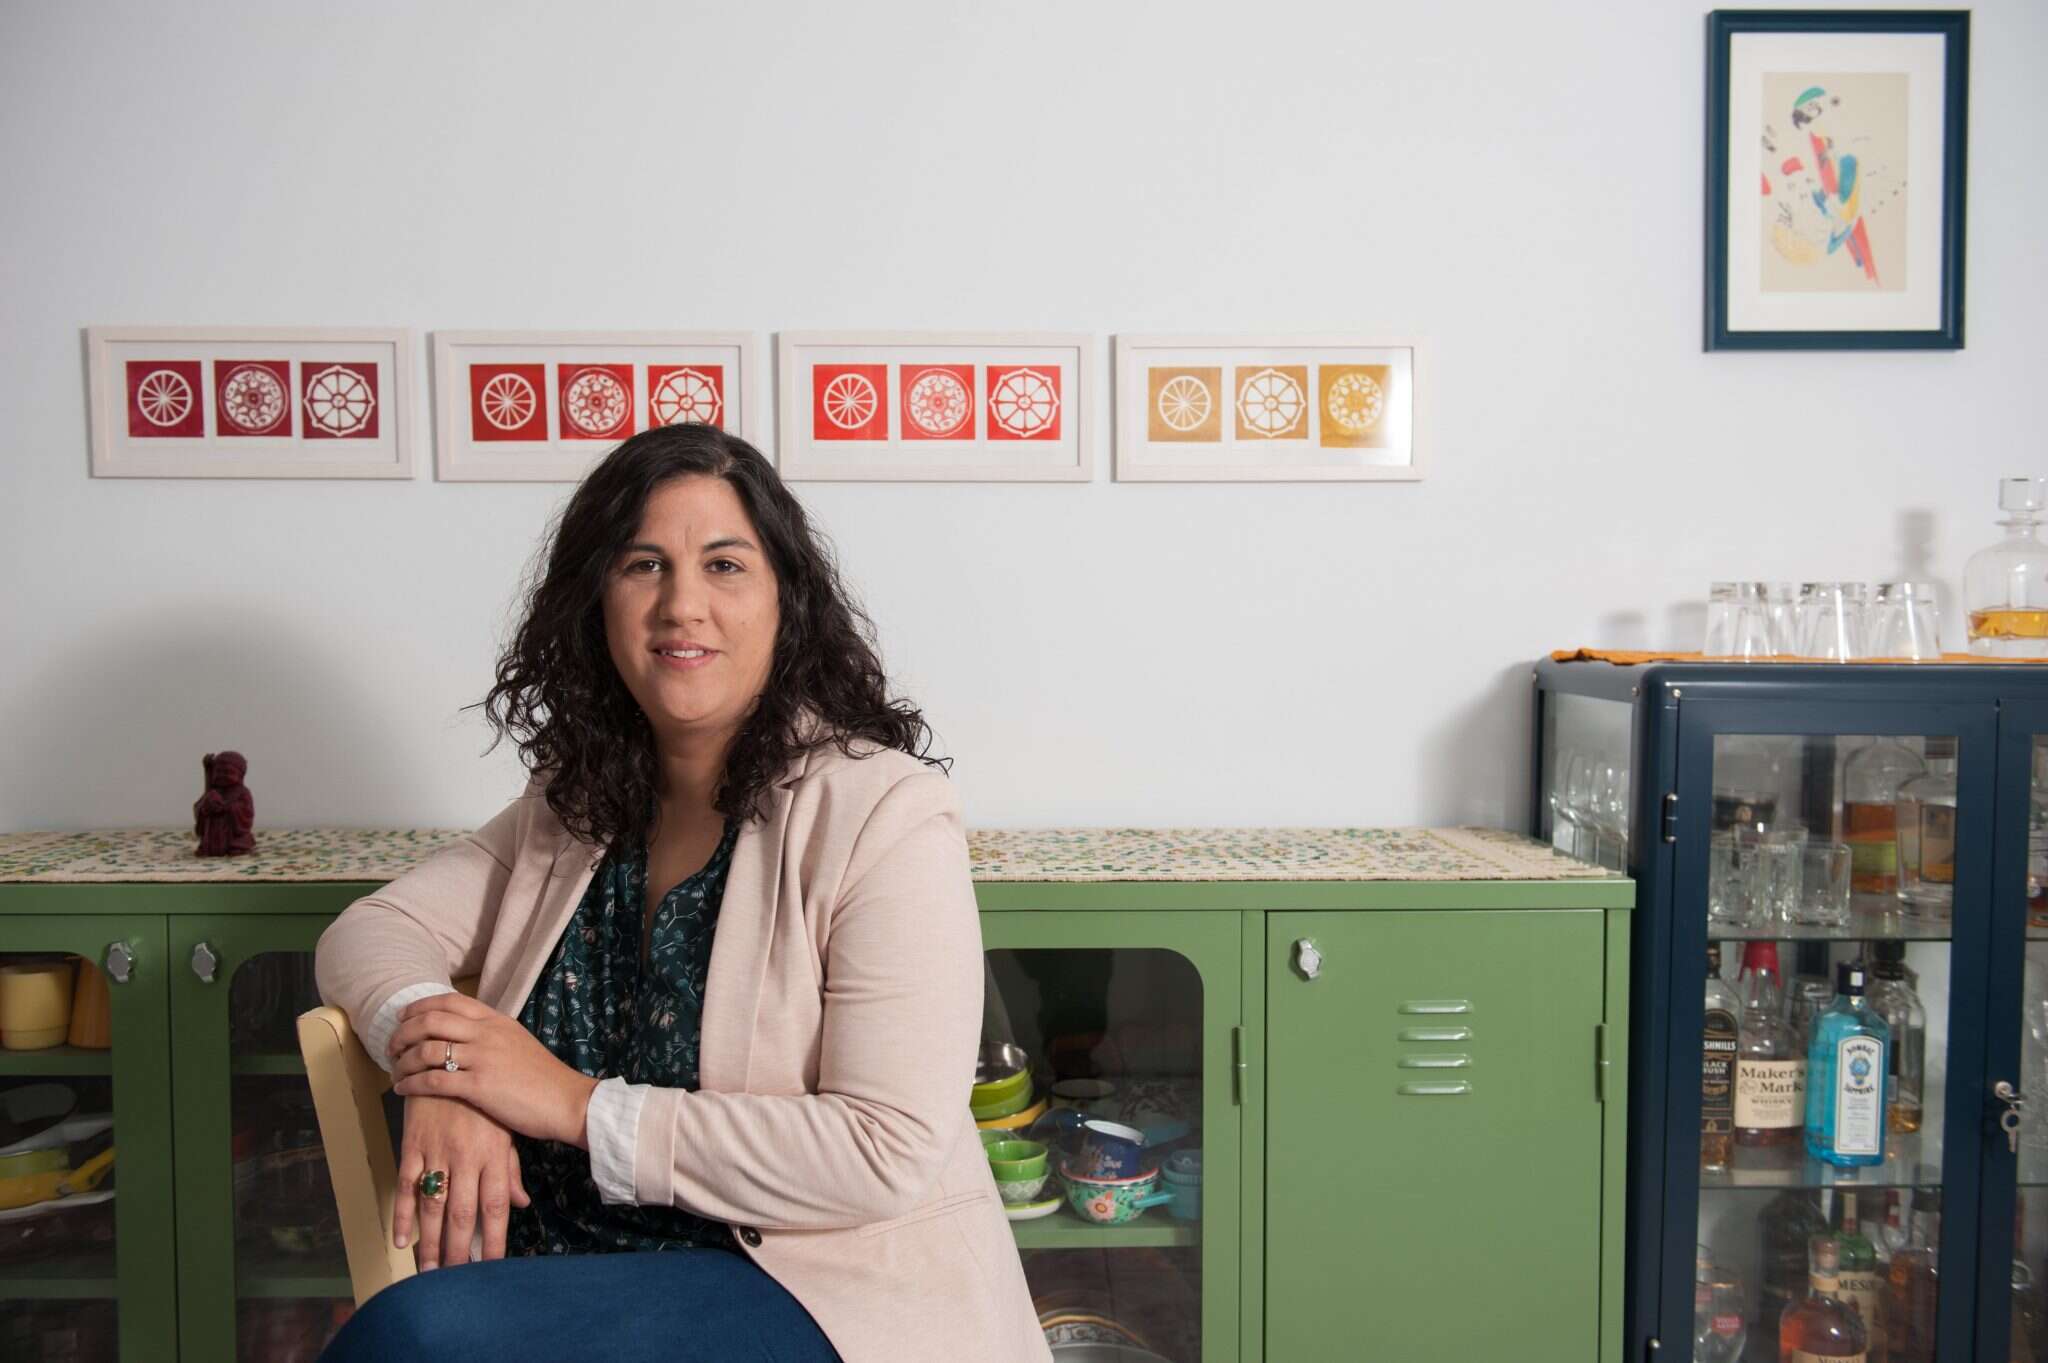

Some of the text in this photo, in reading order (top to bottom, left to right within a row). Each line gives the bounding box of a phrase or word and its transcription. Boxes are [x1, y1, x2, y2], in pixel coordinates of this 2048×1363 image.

[1703, 1040, 1736, 1051] SHMILLS
[1740, 1067, 1805, 1079] Maker's
[1760, 1081, 1803, 1093] Mark
